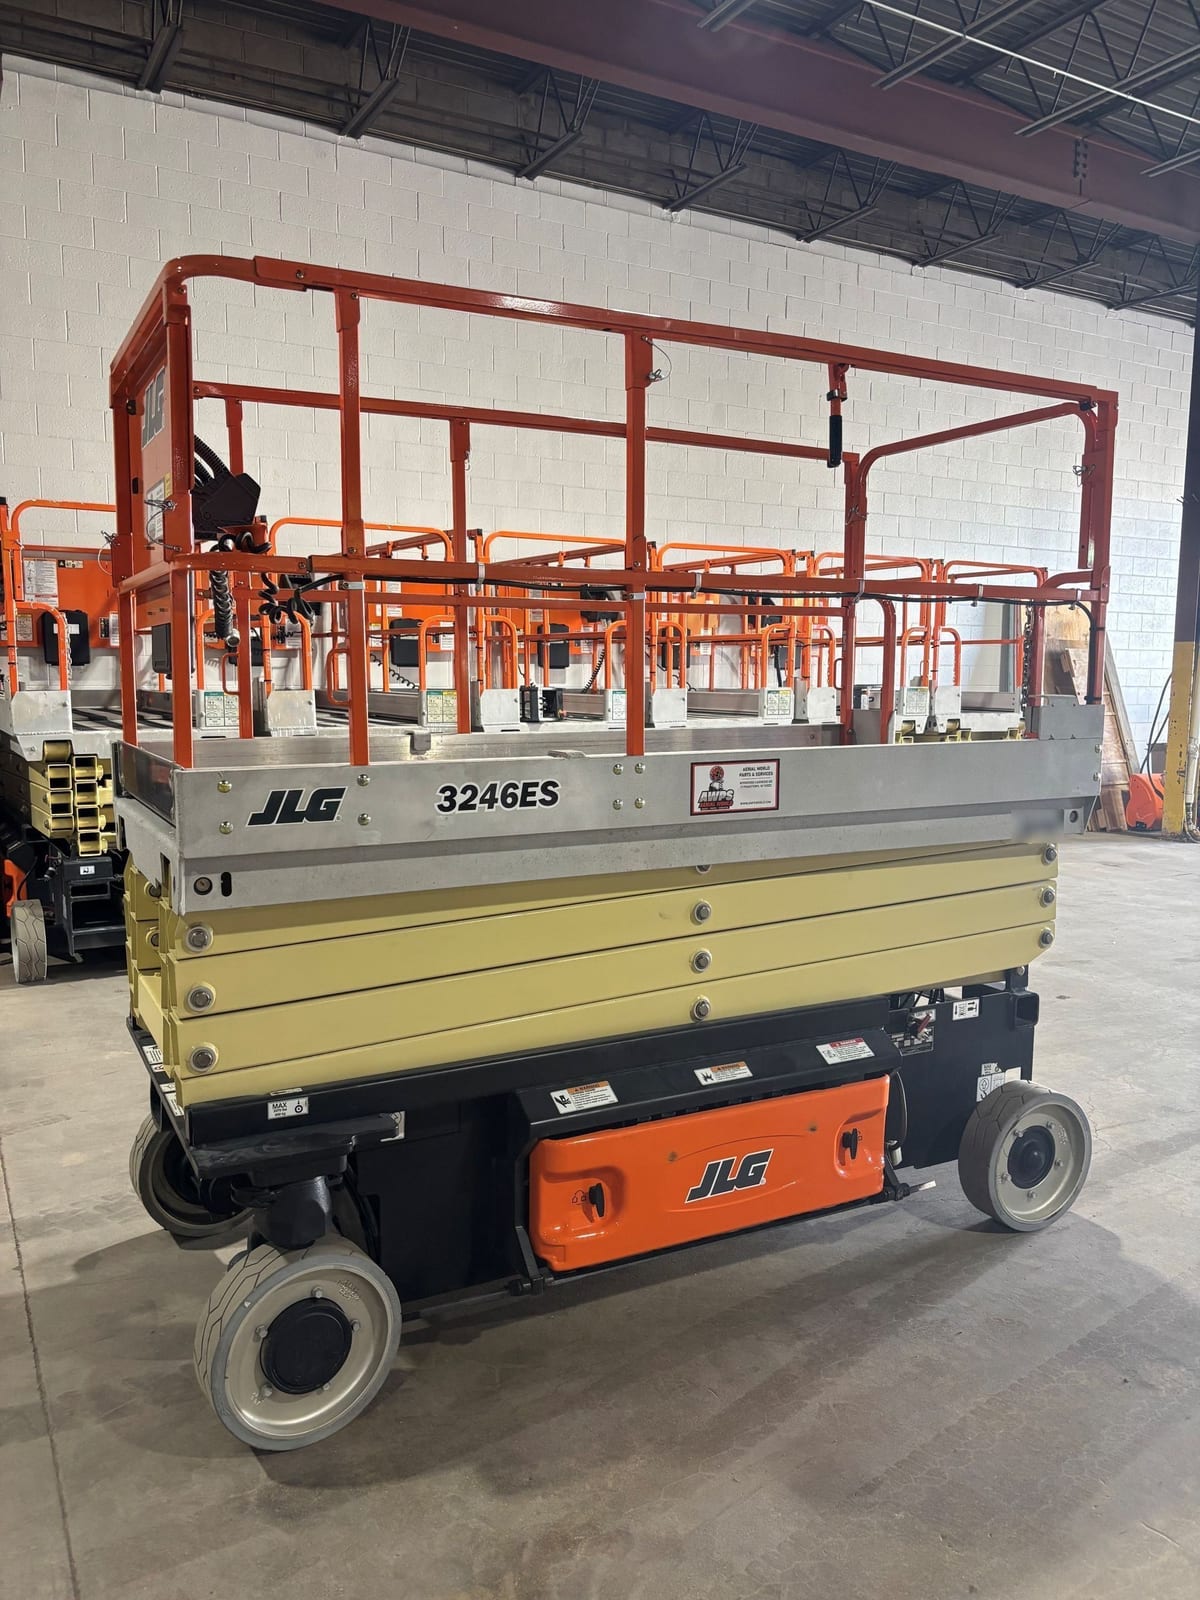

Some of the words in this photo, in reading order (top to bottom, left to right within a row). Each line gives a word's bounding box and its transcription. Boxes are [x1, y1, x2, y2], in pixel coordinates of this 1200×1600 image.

[246, 786, 348, 827] JLG
[435, 779, 561, 814] 3246ES
[698, 789, 734, 802] AWPS
[685, 1149, 774, 1203] JLG
